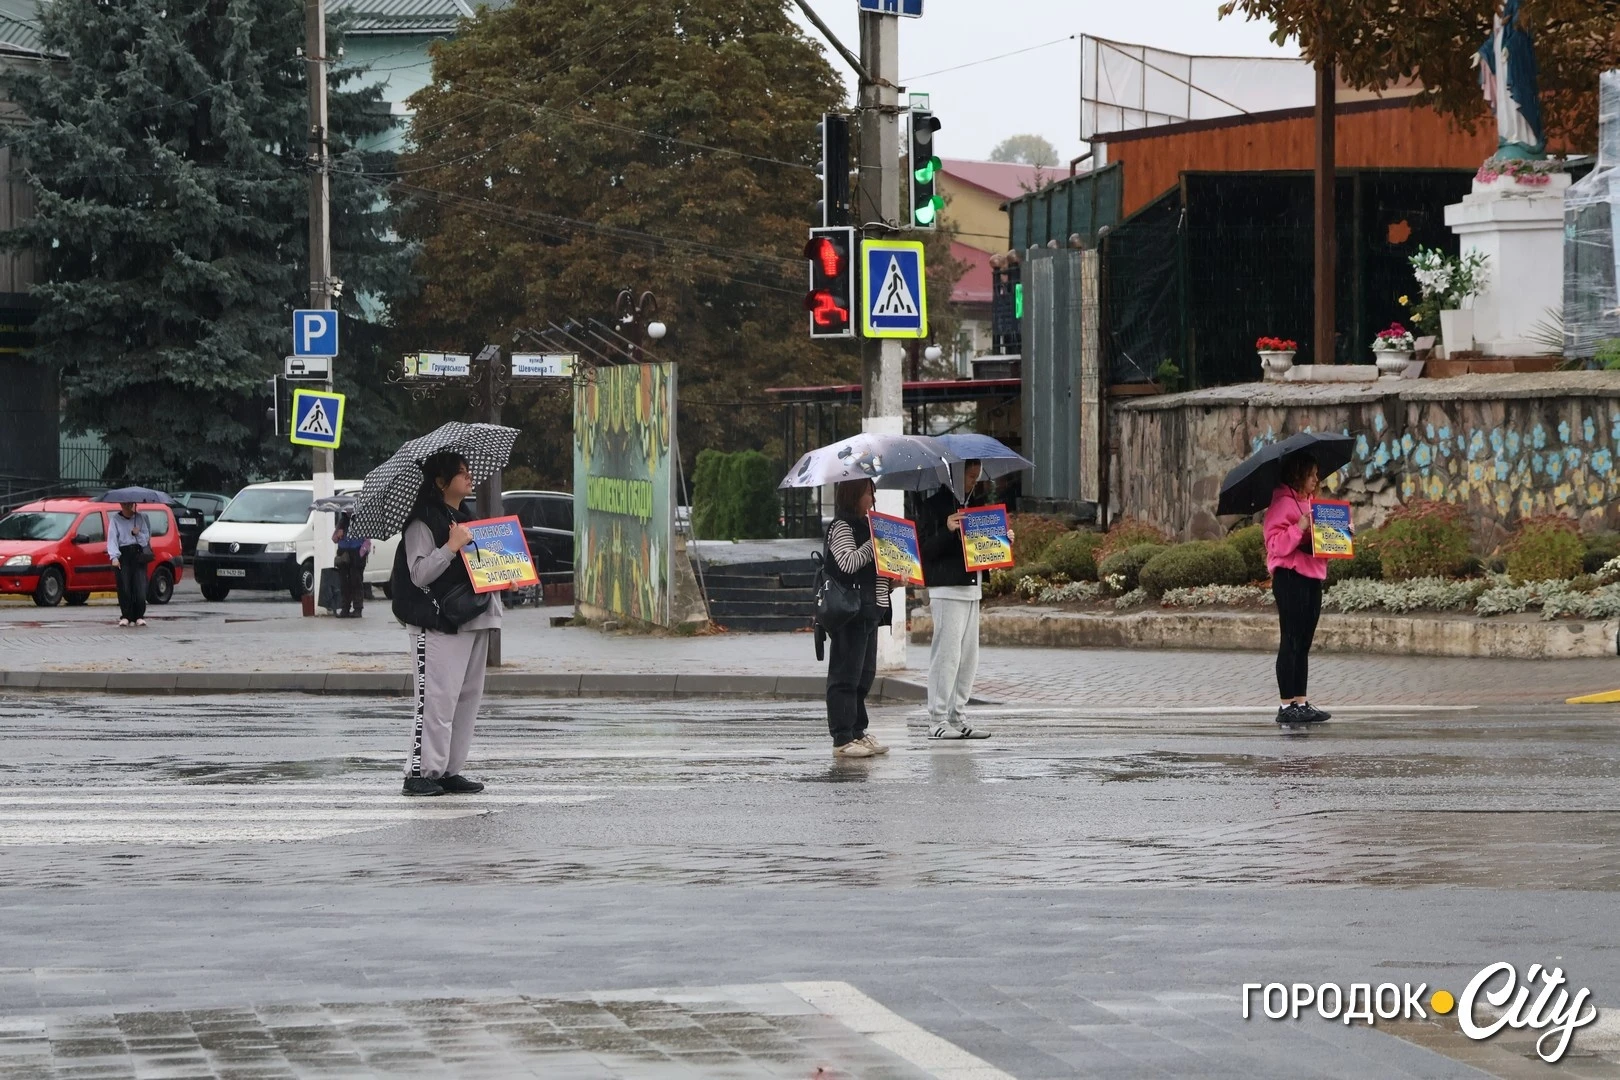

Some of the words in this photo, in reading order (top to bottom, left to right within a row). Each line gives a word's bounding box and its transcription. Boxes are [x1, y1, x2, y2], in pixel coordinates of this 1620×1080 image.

[304, 314, 326, 352] P
[586, 475, 628, 515] КОМПЛЕКСНІ
[628, 479, 653, 525] ОБІДИ
[968, 514, 1000, 528] Загально-
[471, 524, 513, 540] УПИНИСЬ!
[966, 526, 1006, 540] національна
[485, 540, 504, 552] 9:00
[974, 540, 1002, 550] хвилина
[468, 554, 500, 570] ВШАНУЙ
[974, 552, 1006, 564] мовчання
[486, 568, 523, 582] ЗАГИБЛИХ!
